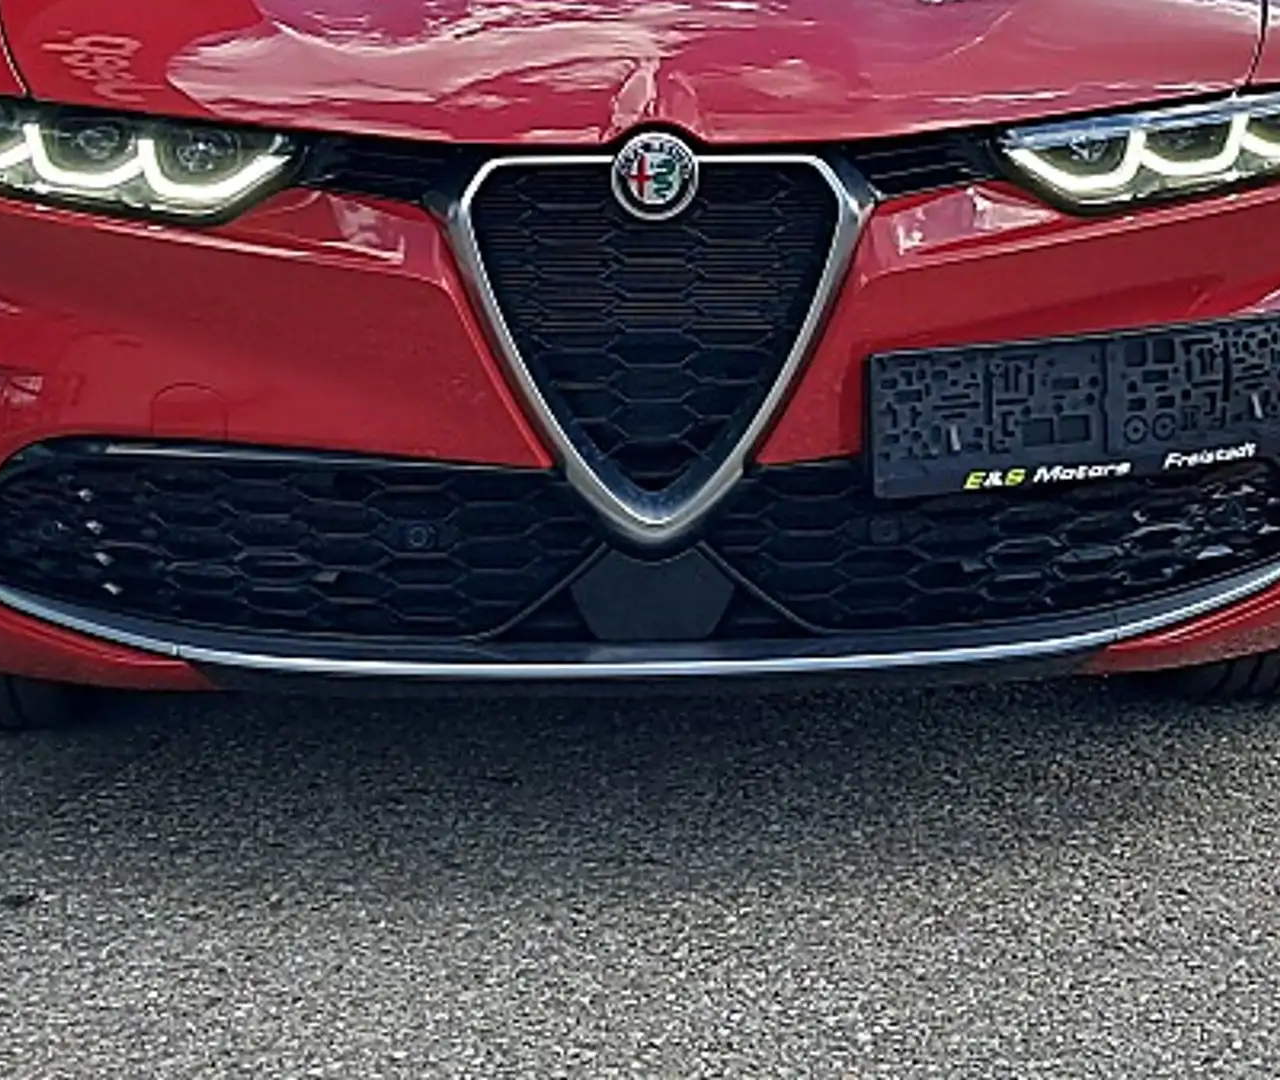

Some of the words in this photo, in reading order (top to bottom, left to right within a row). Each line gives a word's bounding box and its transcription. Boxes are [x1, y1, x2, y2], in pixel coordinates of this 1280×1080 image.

[963, 468, 1027, 491] E&S
[1032, 461, 1131, 484] Motors
[1162, 441, 1258, 470] Freistadt
